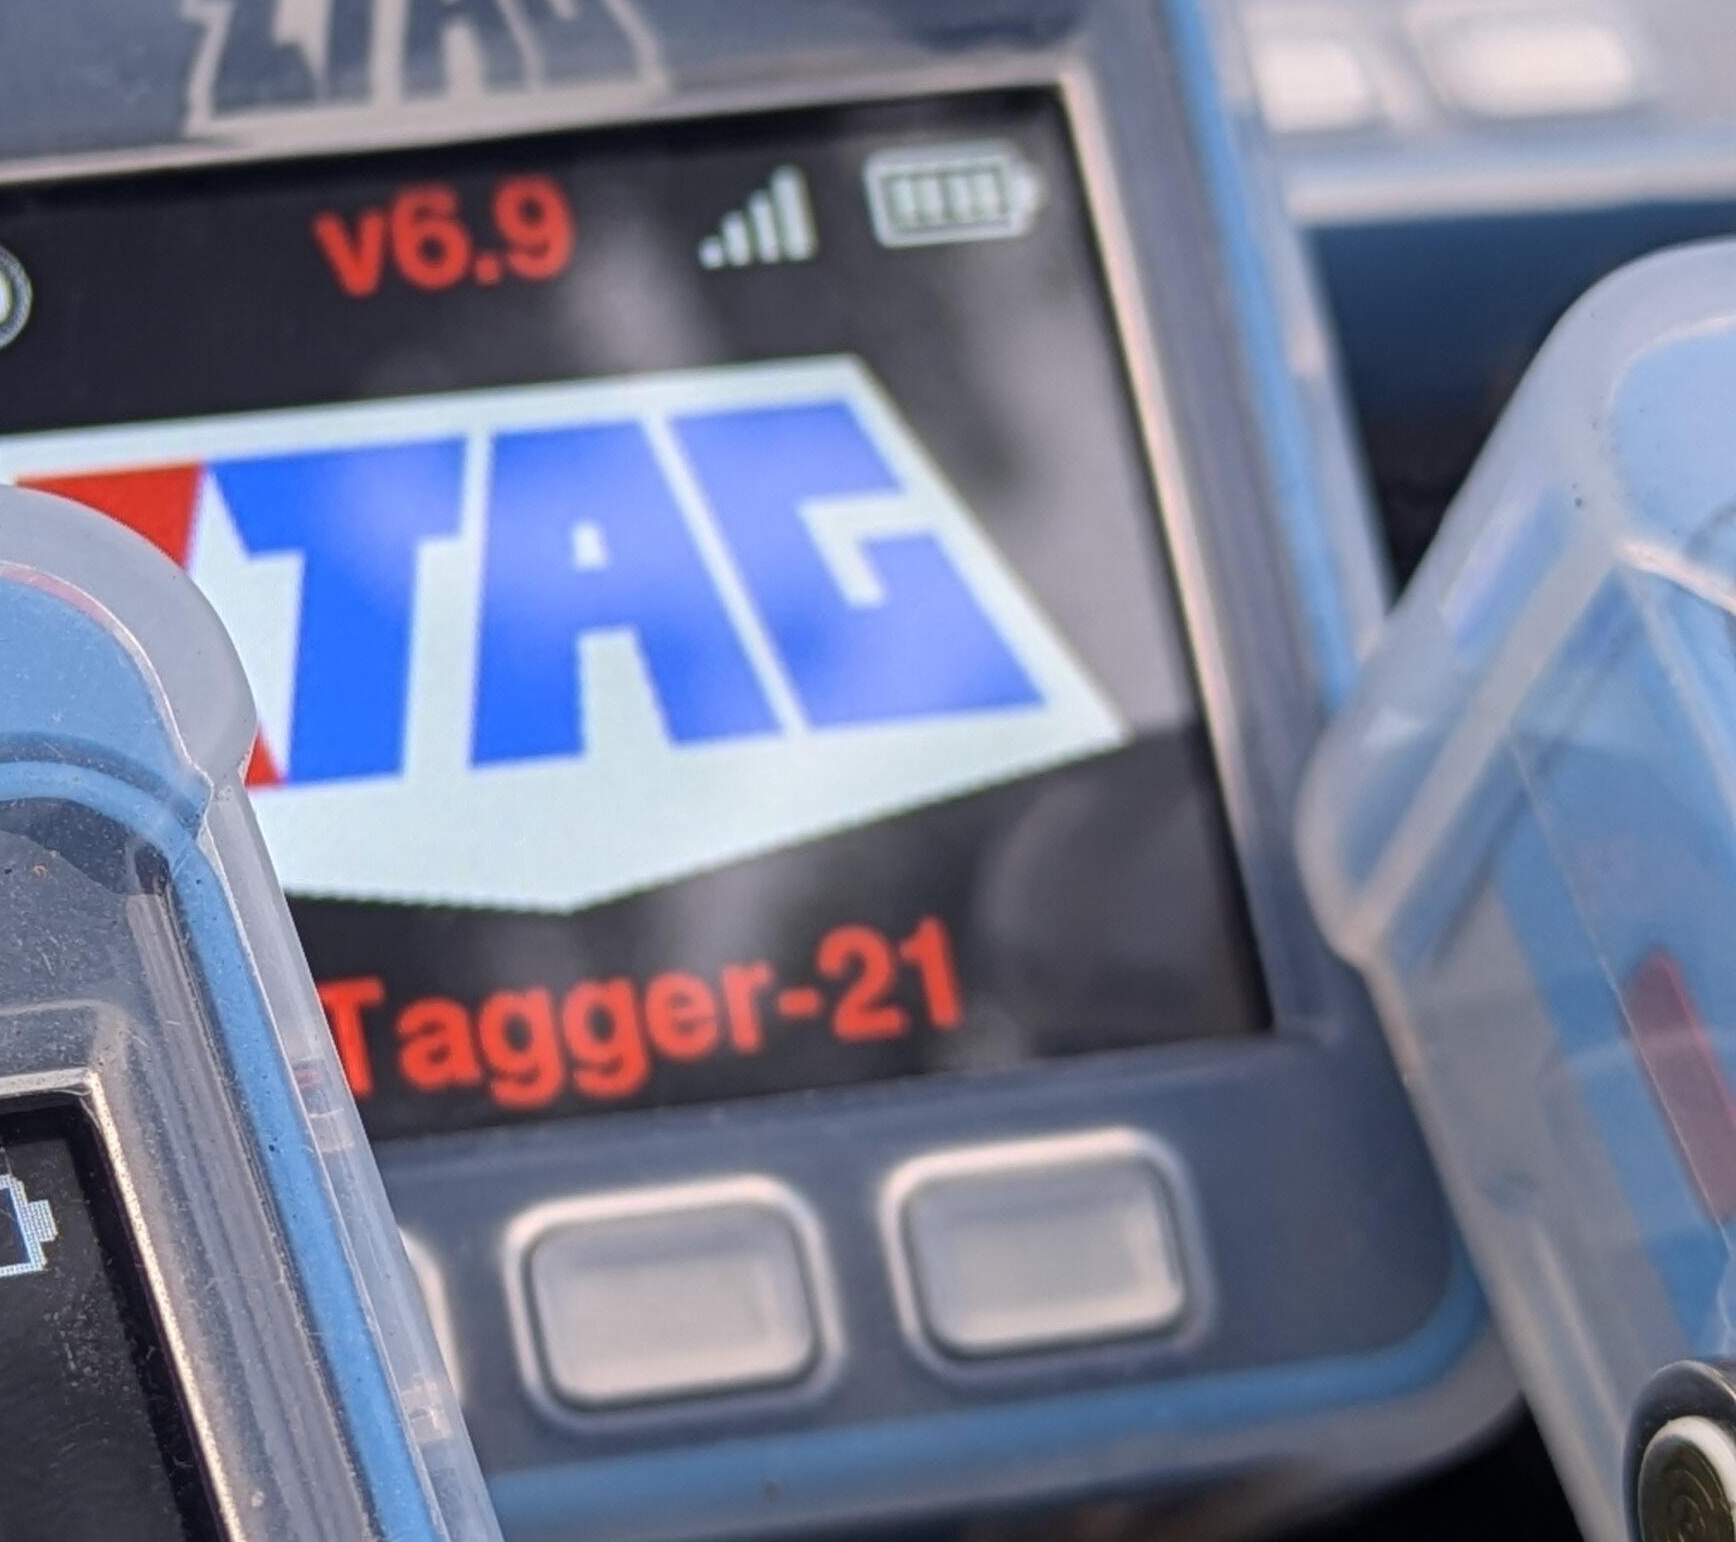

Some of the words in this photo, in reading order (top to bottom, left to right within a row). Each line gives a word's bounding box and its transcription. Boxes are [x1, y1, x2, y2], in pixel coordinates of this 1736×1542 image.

[312, 175, 576, 297] v6.9
[14, 397, 1048, 793] TAG
[310, 915, 964, 1111] Tagger-21
